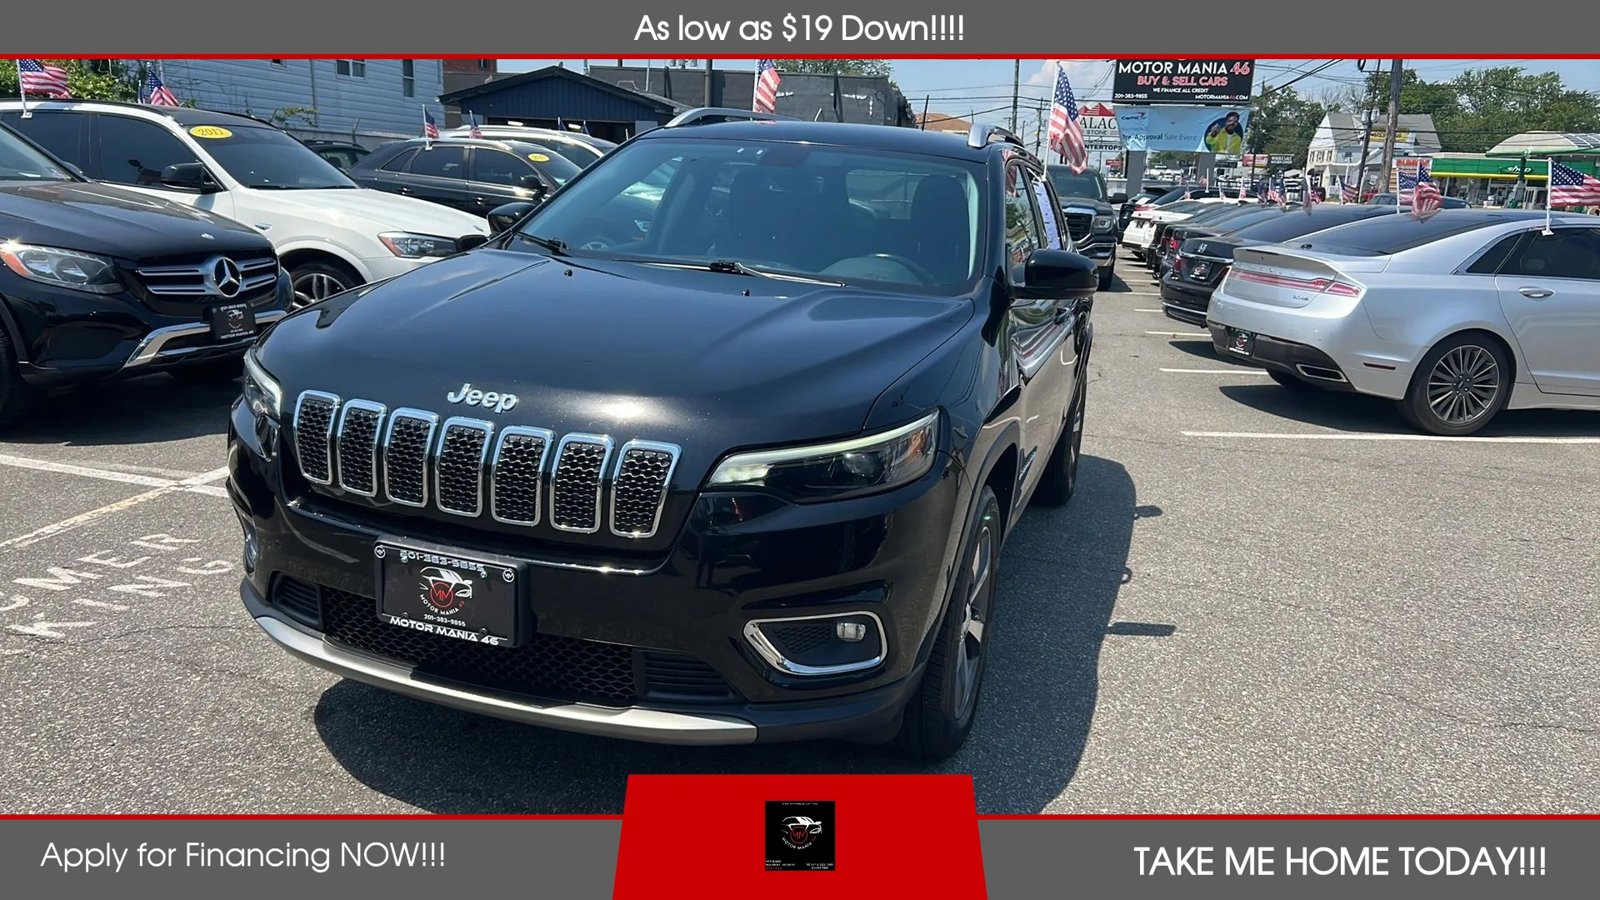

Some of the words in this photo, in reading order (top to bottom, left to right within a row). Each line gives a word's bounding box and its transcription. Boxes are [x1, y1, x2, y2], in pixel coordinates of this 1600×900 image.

[1118, 61, 1172, 75] MOTOR
[1177, 62, 1228, 75] MANIA
[1230, 61, 1250, 76] 46
[1137, 75, 1161, 86] BUY
[1161, 76, 1170, 86] &
[1171, 76, 1197, 86] SELL
[1199, 76, 1228, 86] CARS
[1080, 117, 1117, 130] ALAC
[198, 128, 224, 136] 2017
[1508, 165, 1532, 173] shp
[447, 383, 519, 413] Jeep
[419, 593, 438, 613] MOTOR
[440, 606, 460, 615] MANIA
[389, 616, 434, 634] MOTOR
[436, 626, 478, 642] MANIA
[480, 636, 499, 646] 46
